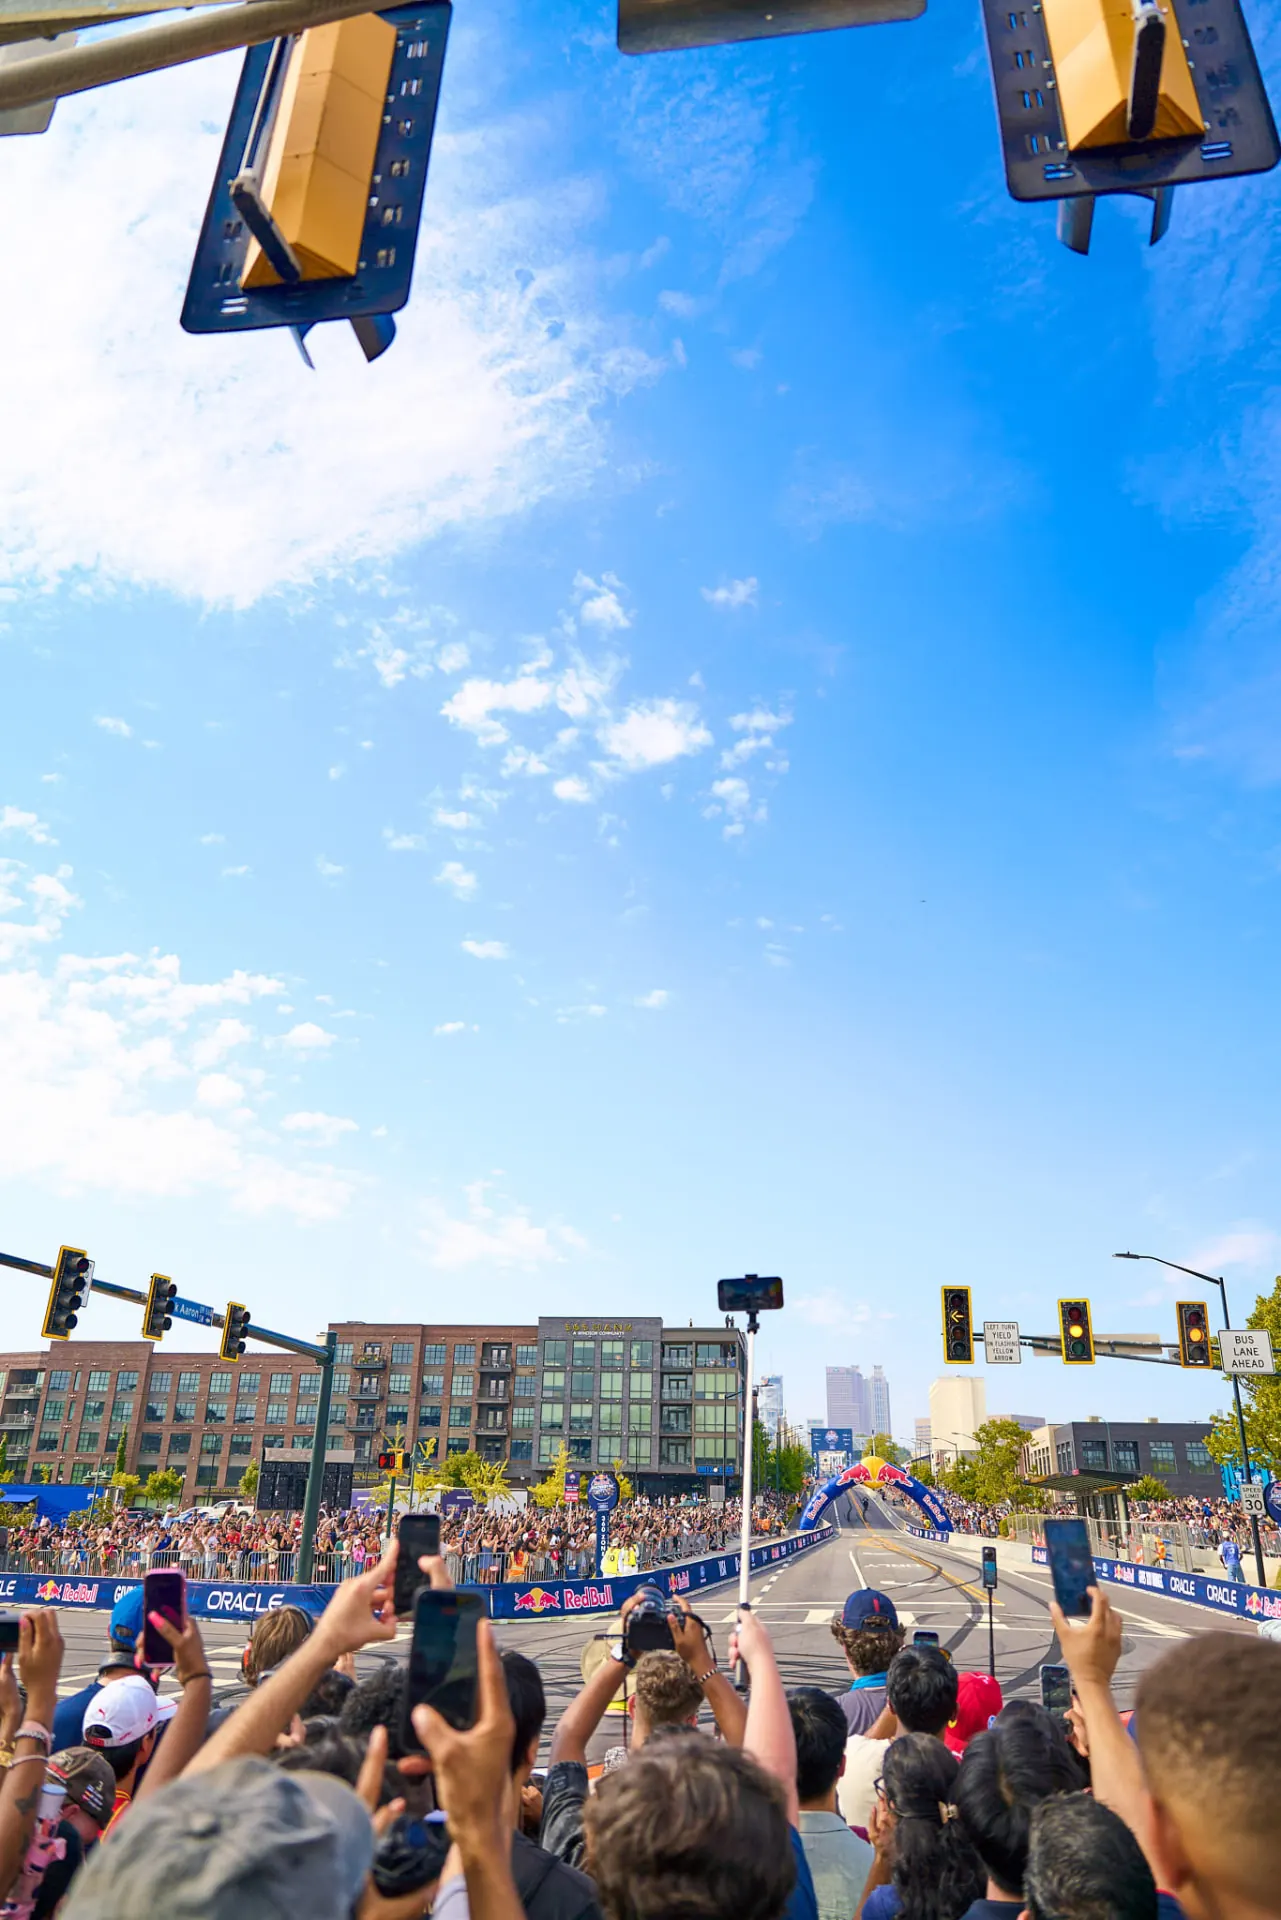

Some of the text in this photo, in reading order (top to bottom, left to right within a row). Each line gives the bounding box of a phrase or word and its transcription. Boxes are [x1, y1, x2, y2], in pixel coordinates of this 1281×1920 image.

[180, 1303, 199, 1318] Aaron
[1234, 1336, 1254, 1344] BUS
[1234, 1348, 1259, 1356] LANE
[1232, 1360, 1264, 1368] AHEAD
[1246, 1500, 1262, 1510] 30
[1170, 1576, 1195, 1596] ORACLE
[206, 1591, 284, 1612] ORACLE
[1206, 1584, 1237, 1607] ORACLE
